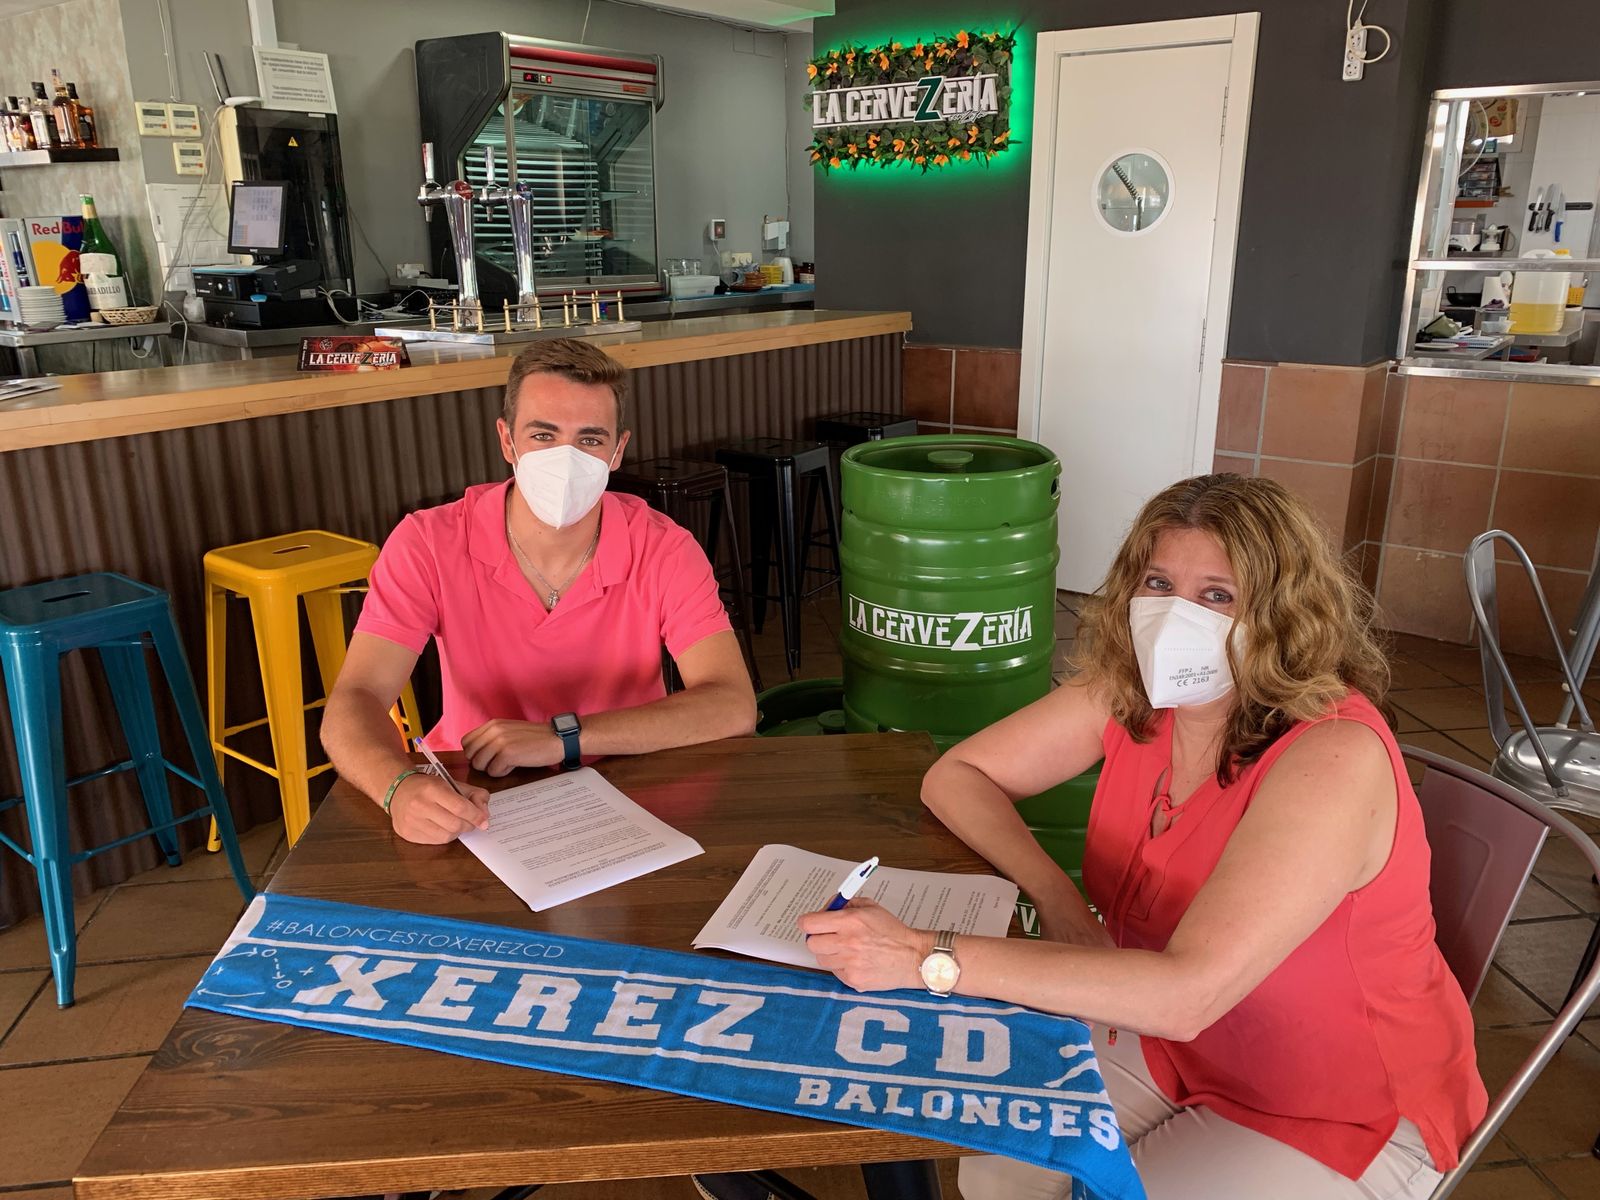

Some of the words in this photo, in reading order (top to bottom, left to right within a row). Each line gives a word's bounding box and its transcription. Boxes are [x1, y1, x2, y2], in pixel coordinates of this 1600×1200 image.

[813, 91, 842, 124] LA
[846, 72, 998, 122] CERVEZERÍA
[31, 221, 60, 235] Red
[309, 354, 324, 365] LA
[849, 597, 867, 632] LA
[872, 606, 1032, 651] CERVEZERÍA
[265, 919, 565, 959] #BALONCESTOXEREZCD
[292, 953, 766, 1051] XEREZ
[834, 1005, 1012, 1078] CD
[794, 1078, 1120, 1152] BALONCES
